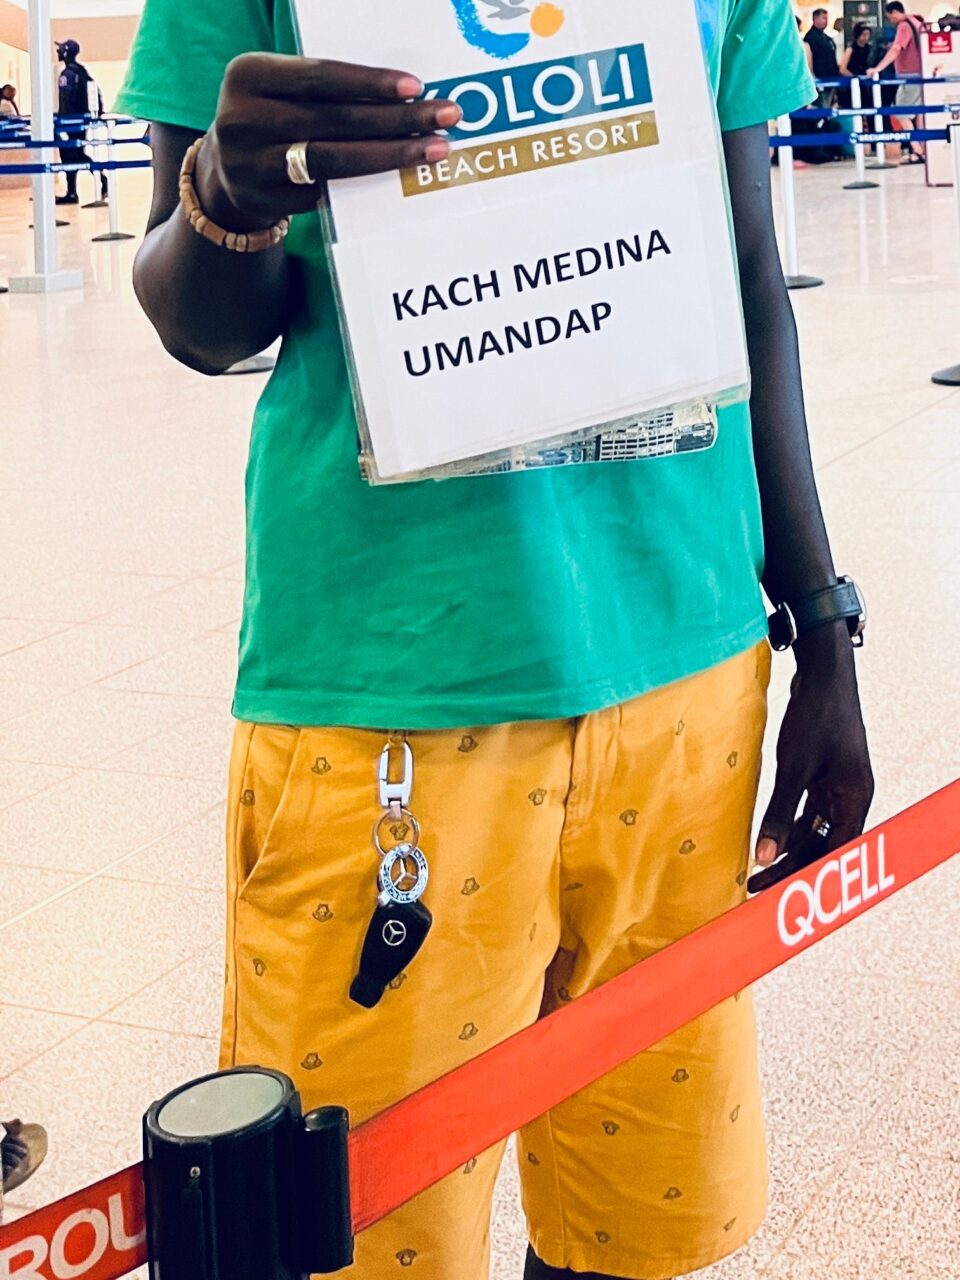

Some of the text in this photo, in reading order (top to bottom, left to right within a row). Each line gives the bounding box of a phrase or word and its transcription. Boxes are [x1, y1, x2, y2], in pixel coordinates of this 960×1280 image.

[404, 53, 635, 136] OLOLI
[416, 120, 642, 186] BEACH RESORT
[392, 228, 672, 321] KACH MEDINA
[403, 301, 613, 377] UMANDAP
[777, 833, 895, 946] QCELL
